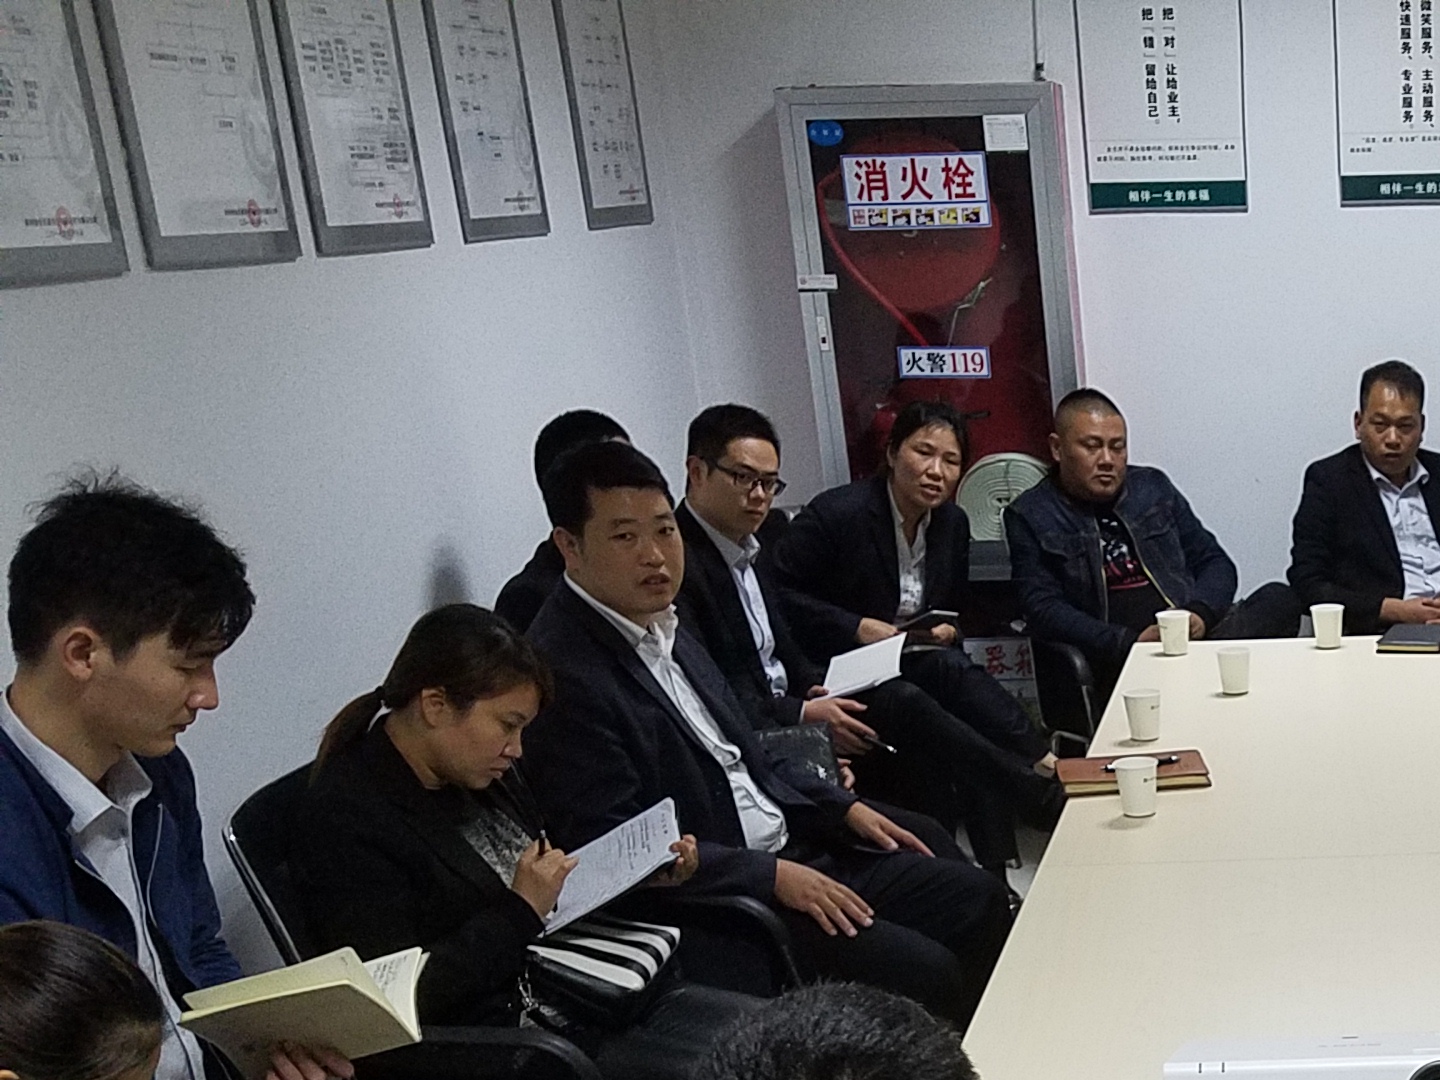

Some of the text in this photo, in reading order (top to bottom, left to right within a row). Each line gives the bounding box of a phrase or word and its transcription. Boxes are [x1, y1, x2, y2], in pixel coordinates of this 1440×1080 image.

[854, 157, 976, 202] 消火栓
[1128, 188, 1210, 203] 相伴一生的幸福
